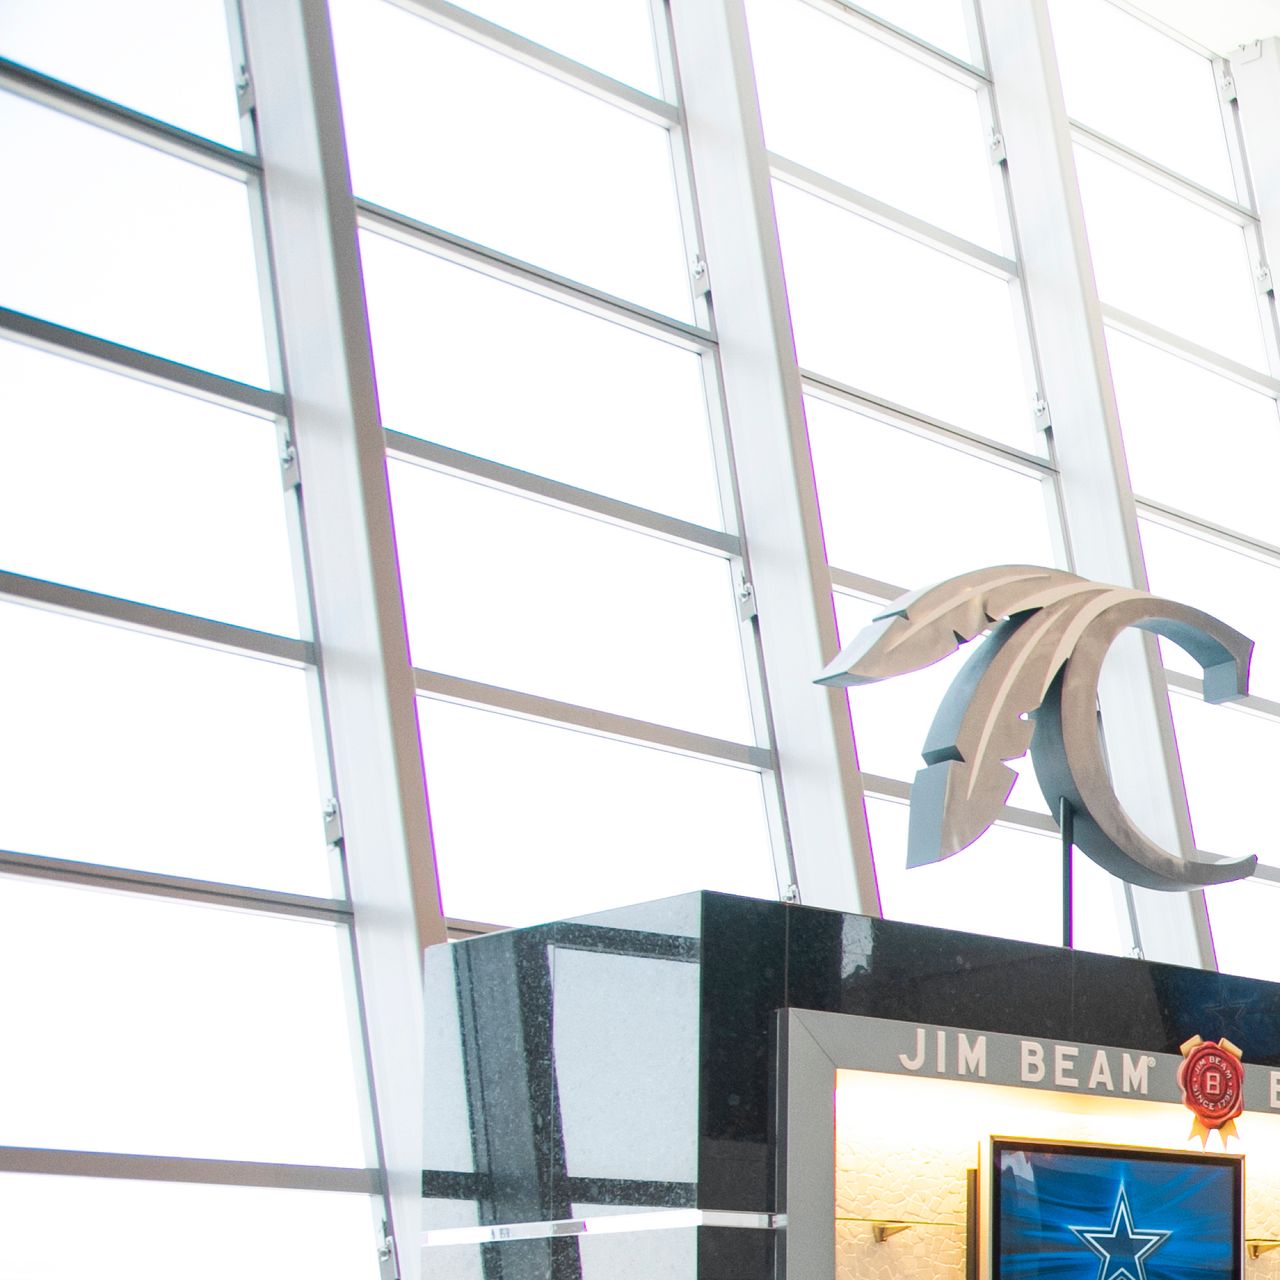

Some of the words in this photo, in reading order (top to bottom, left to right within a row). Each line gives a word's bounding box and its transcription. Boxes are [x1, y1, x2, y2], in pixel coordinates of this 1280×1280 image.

[898, 1026, 989, 1078] JIM
[1194, 1059, 1206, 1075] JIM
[1209, 1055, 1233, 1079] BEAM
[1206, 1071, 1221, 1095] B
[1192, 1084, 1216, 1110] SINCE
[1217, 1088, 1233, 1109] 1795
